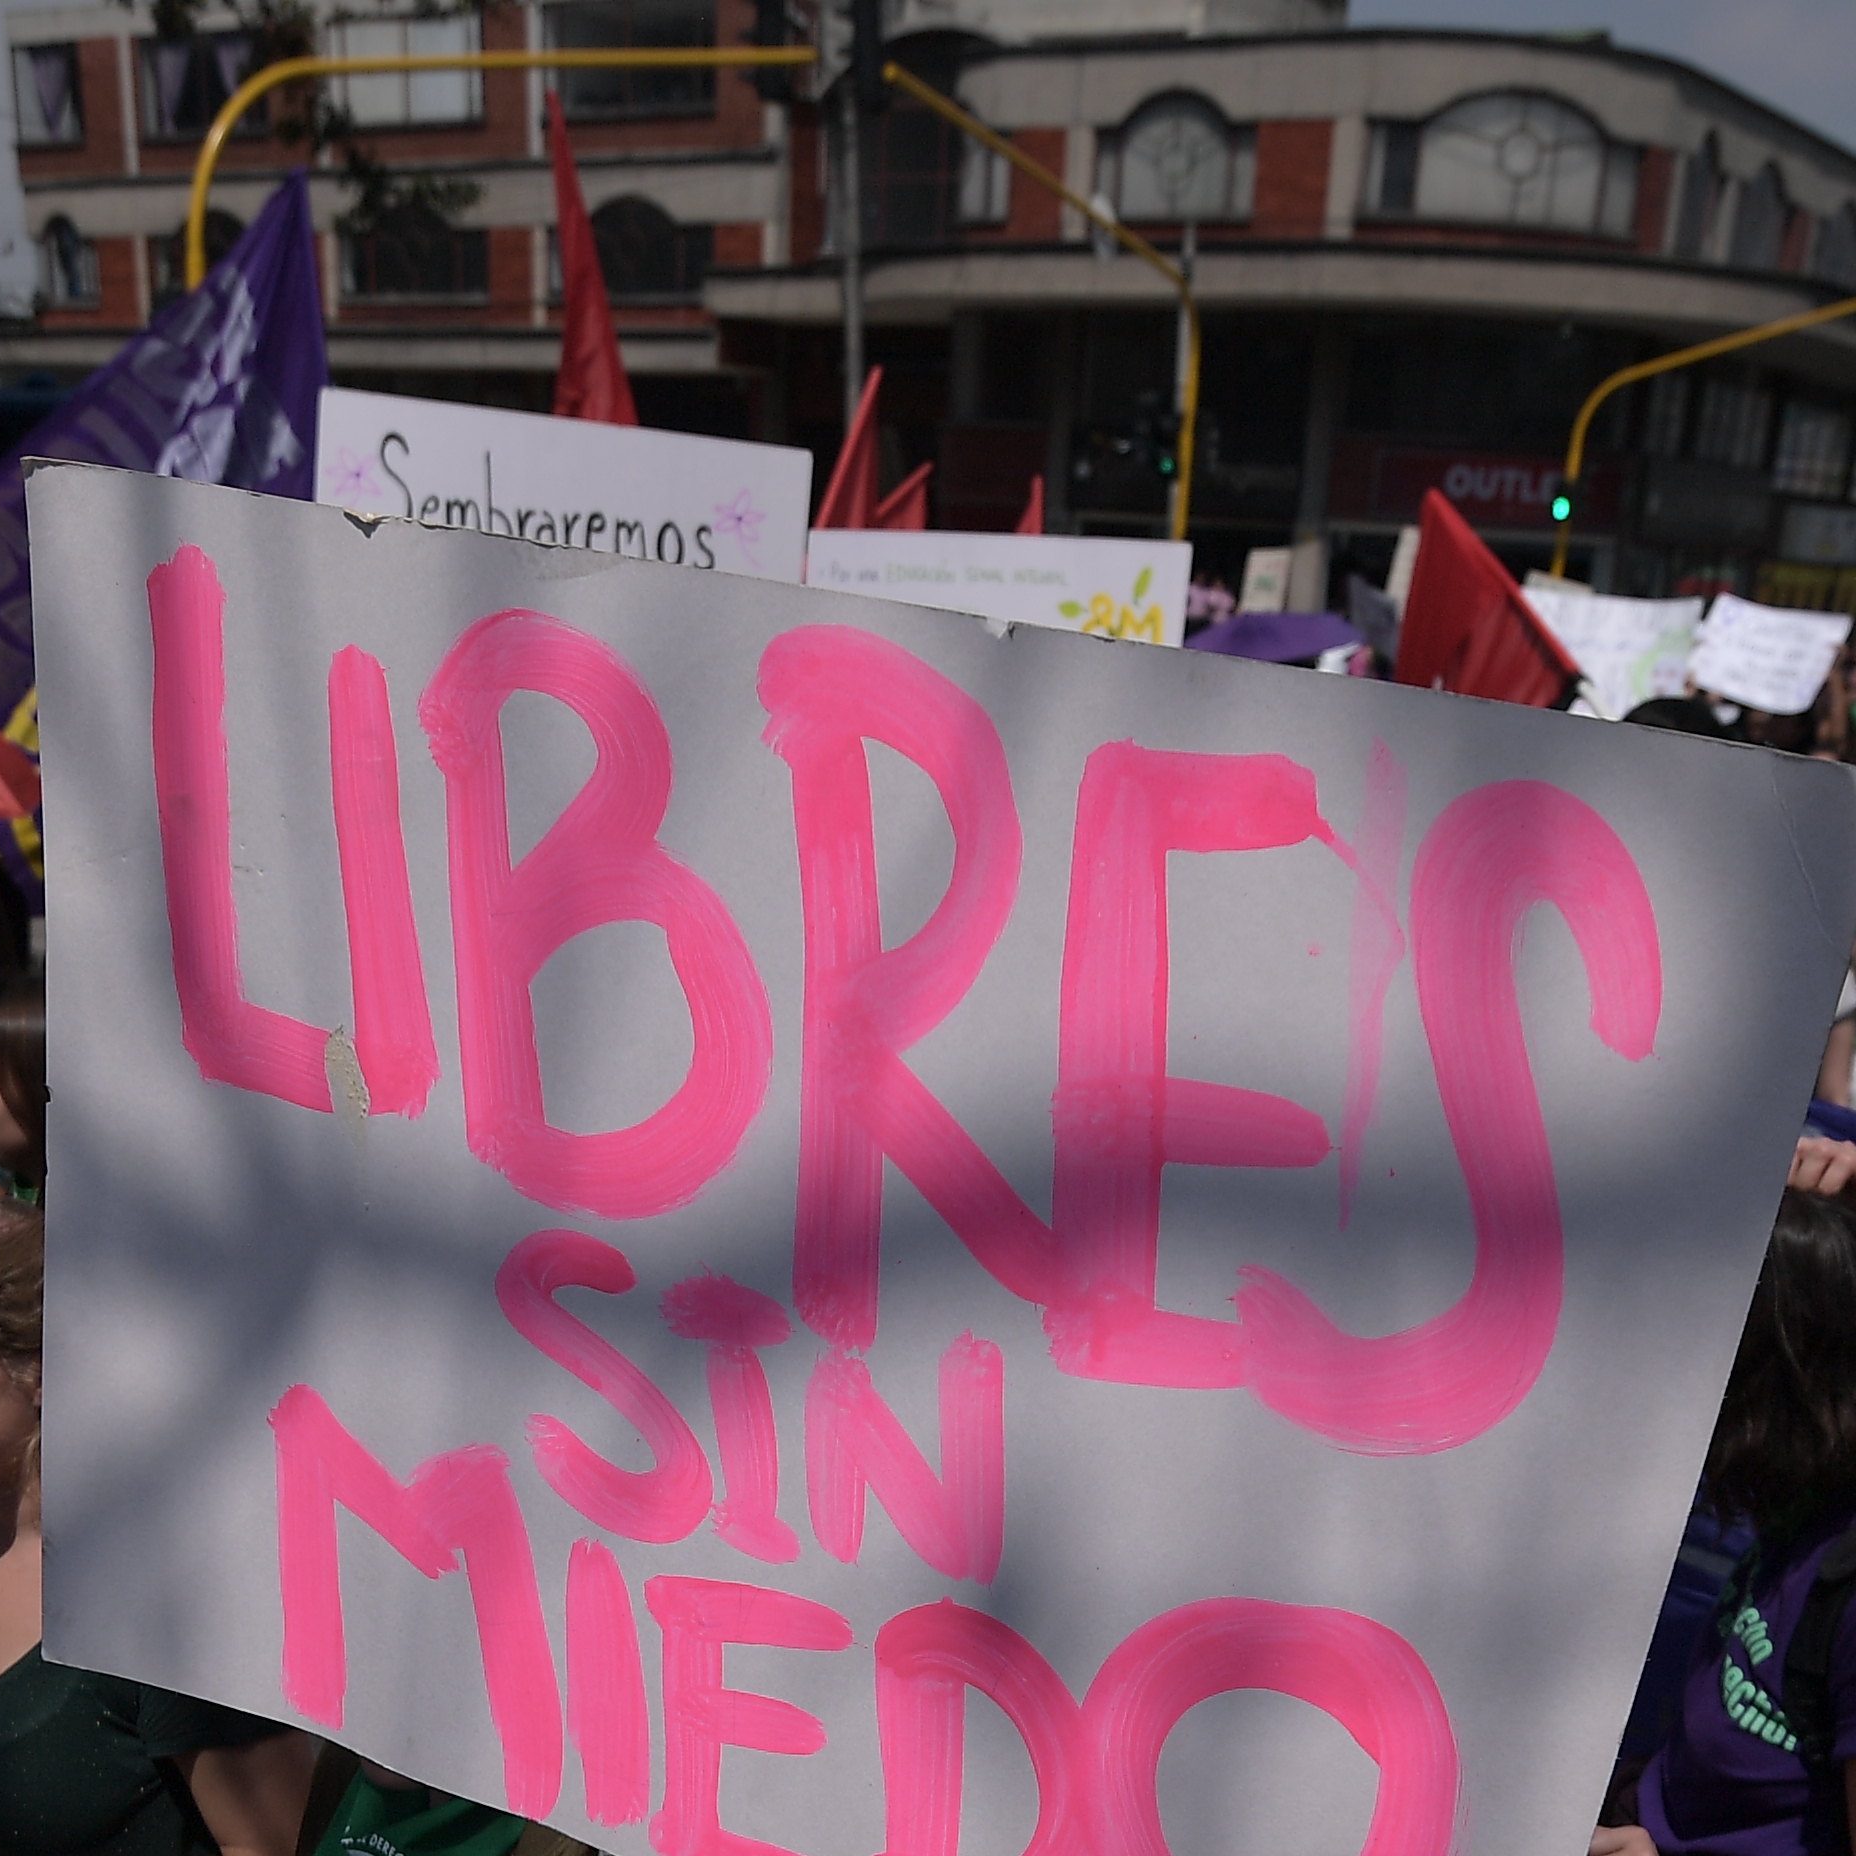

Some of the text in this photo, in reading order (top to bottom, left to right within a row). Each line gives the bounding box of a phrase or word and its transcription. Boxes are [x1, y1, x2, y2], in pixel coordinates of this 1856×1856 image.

[379, 432, 717, 570] Sembraremos
[1444, 462, 1569, 506] OUTLE
[146, 542, 1662, 1457] LIBRES
[494, 1226, 1006, 1585] SIN
